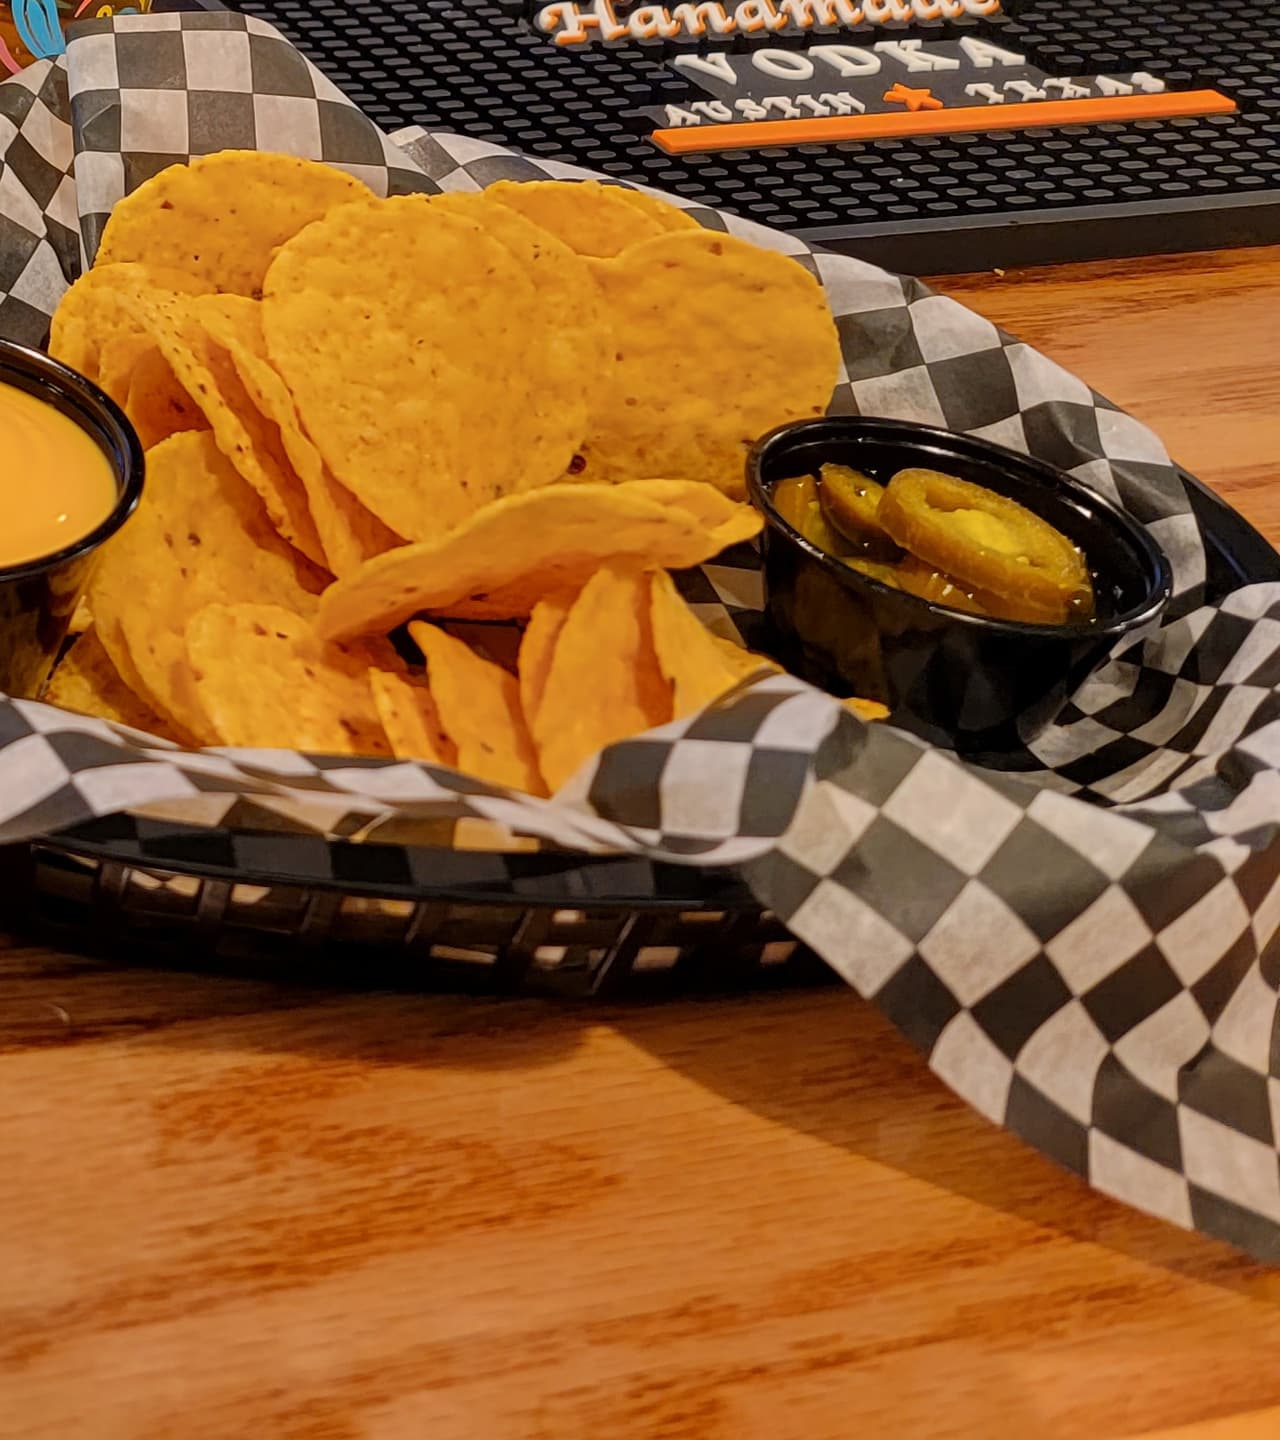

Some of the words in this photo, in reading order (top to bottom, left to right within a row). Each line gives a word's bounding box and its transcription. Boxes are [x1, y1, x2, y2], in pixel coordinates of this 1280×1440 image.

[675, 36, 1026, 85] VODKA
[664, 91, 867, 127] AUSTIN
[965, 71, 1166, 105] TEXAS
